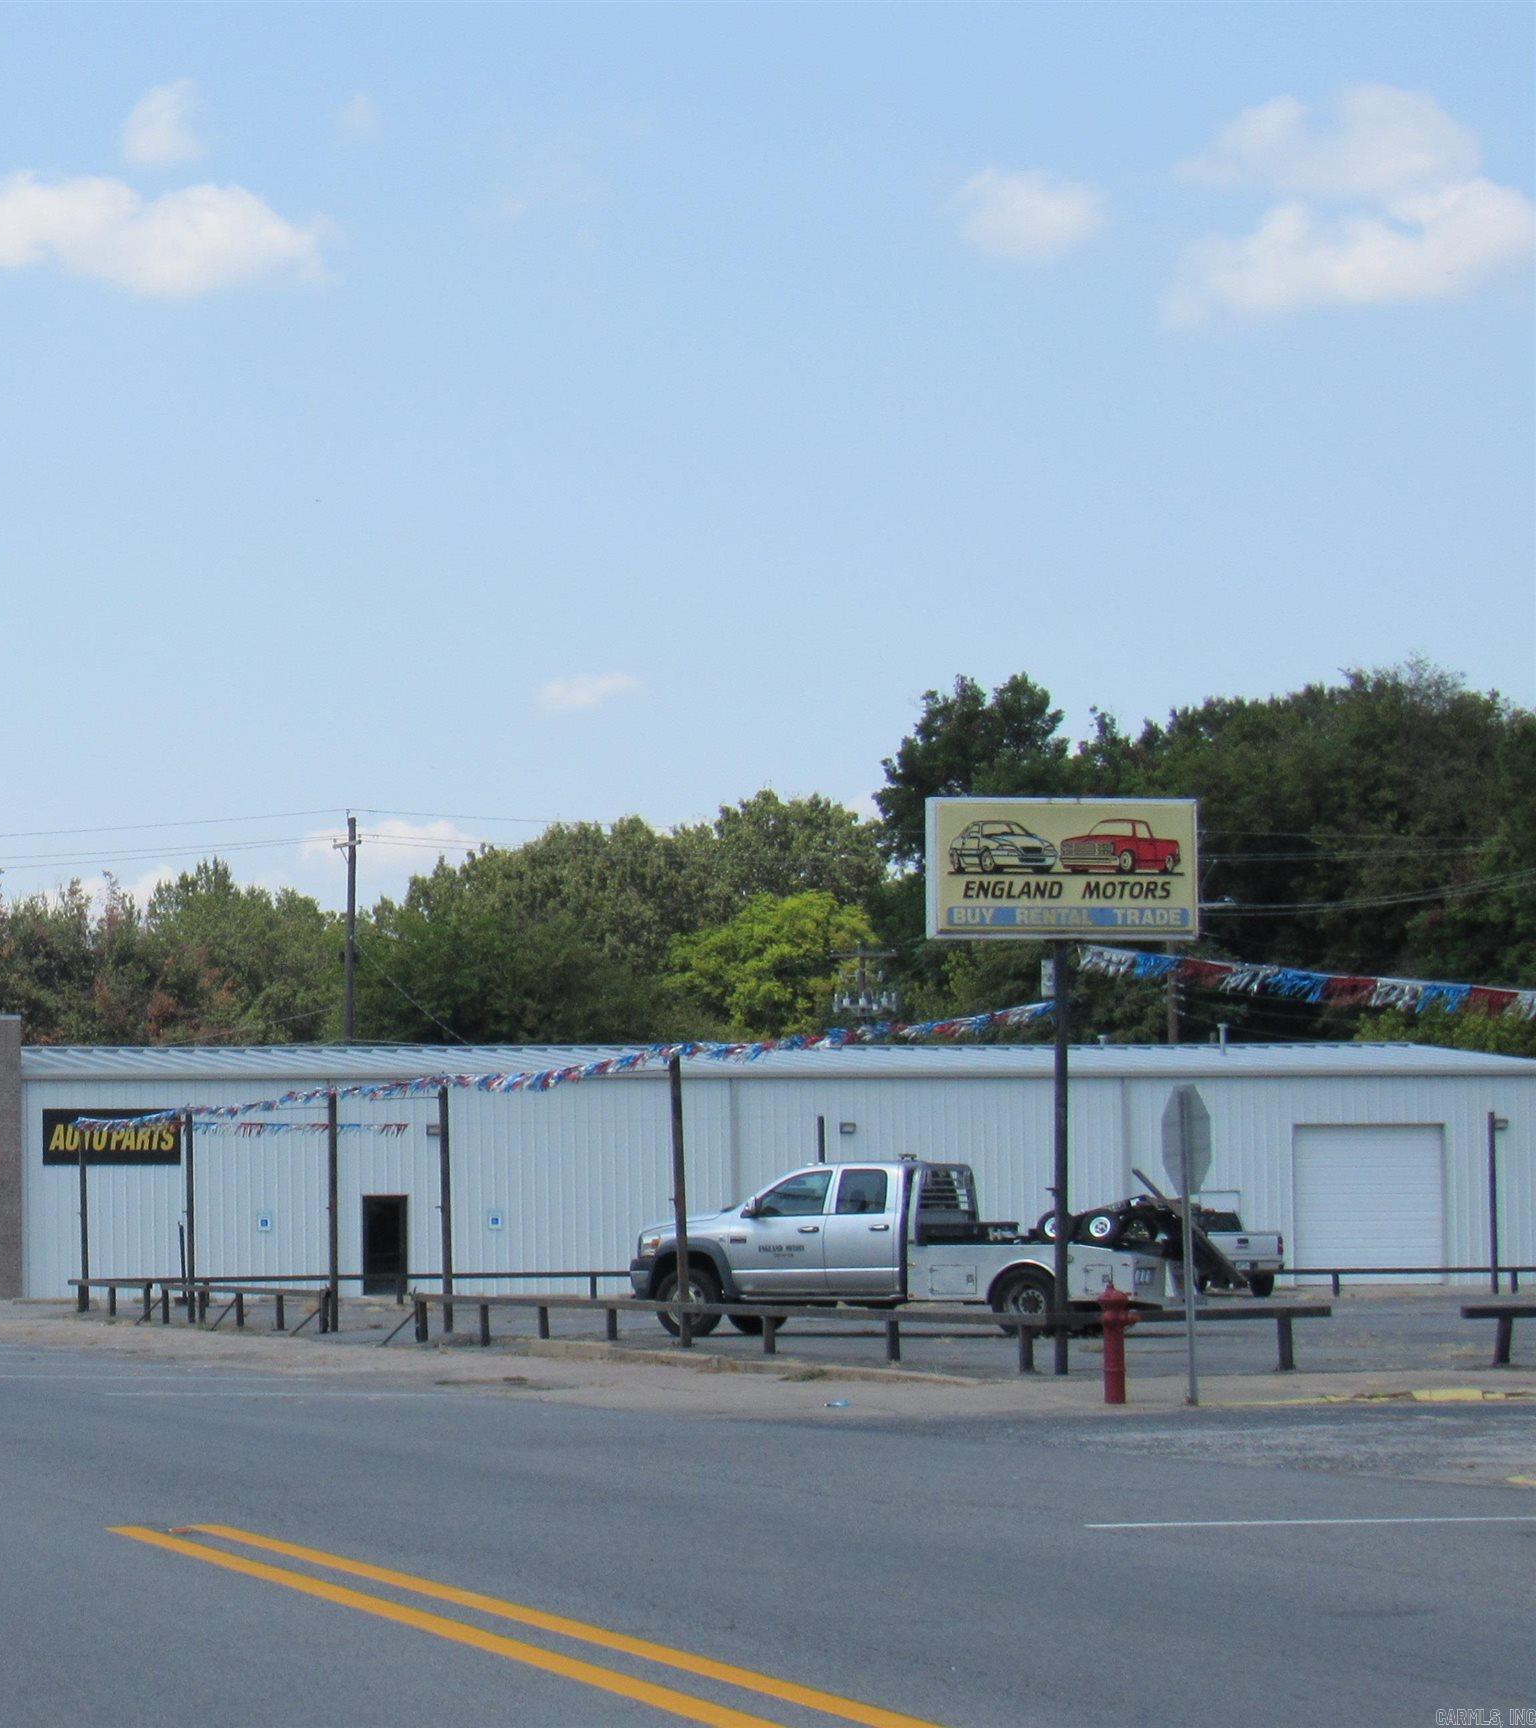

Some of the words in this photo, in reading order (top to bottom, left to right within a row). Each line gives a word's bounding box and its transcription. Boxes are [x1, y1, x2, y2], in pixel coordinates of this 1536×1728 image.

[963, 880, 1063, 900] ENGLAND
[1082, 880, 1171, 900] MOTORS
[954, 908, 994, 925] BUY
[1016, 908, 1092, 926] RENTAL
[1115, 908, 1181, 925] TRADE
